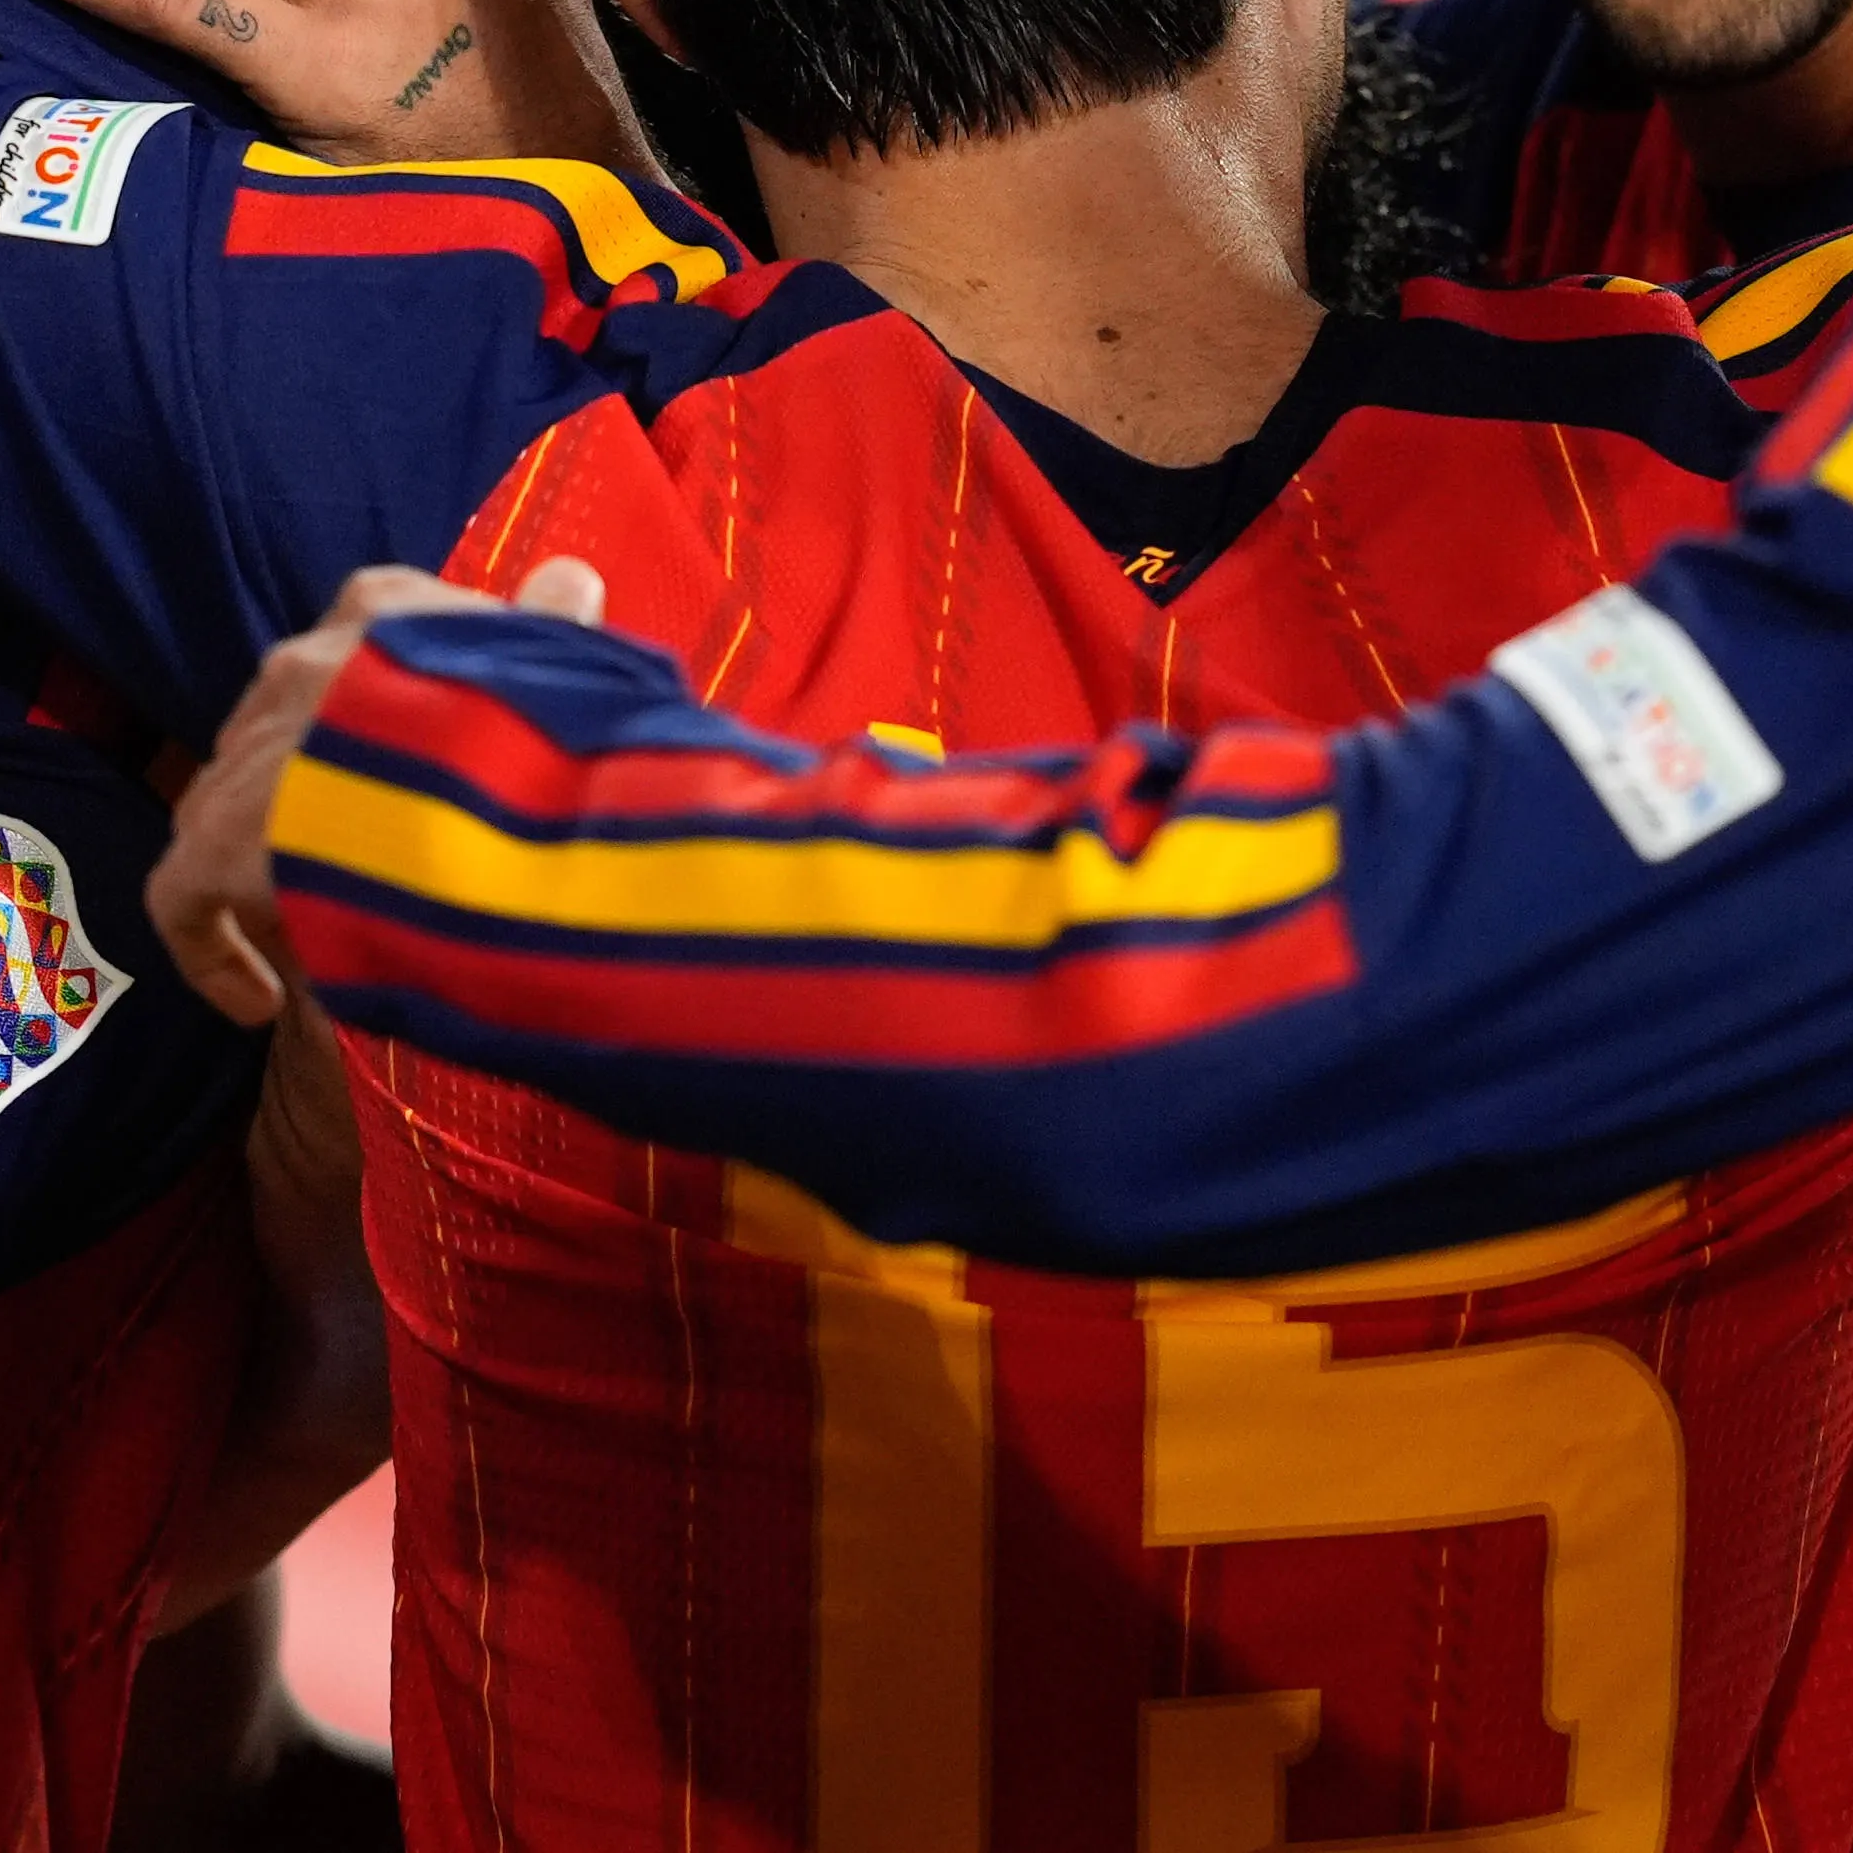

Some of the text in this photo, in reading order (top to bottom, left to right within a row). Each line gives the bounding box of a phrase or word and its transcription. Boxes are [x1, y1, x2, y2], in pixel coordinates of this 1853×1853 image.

[394, 23, 473, 111] OHANA
[13, 116, 41, 139] for
[19, 101, 112, 229] ATION
[726, 1161, 1686, 1853] 15
